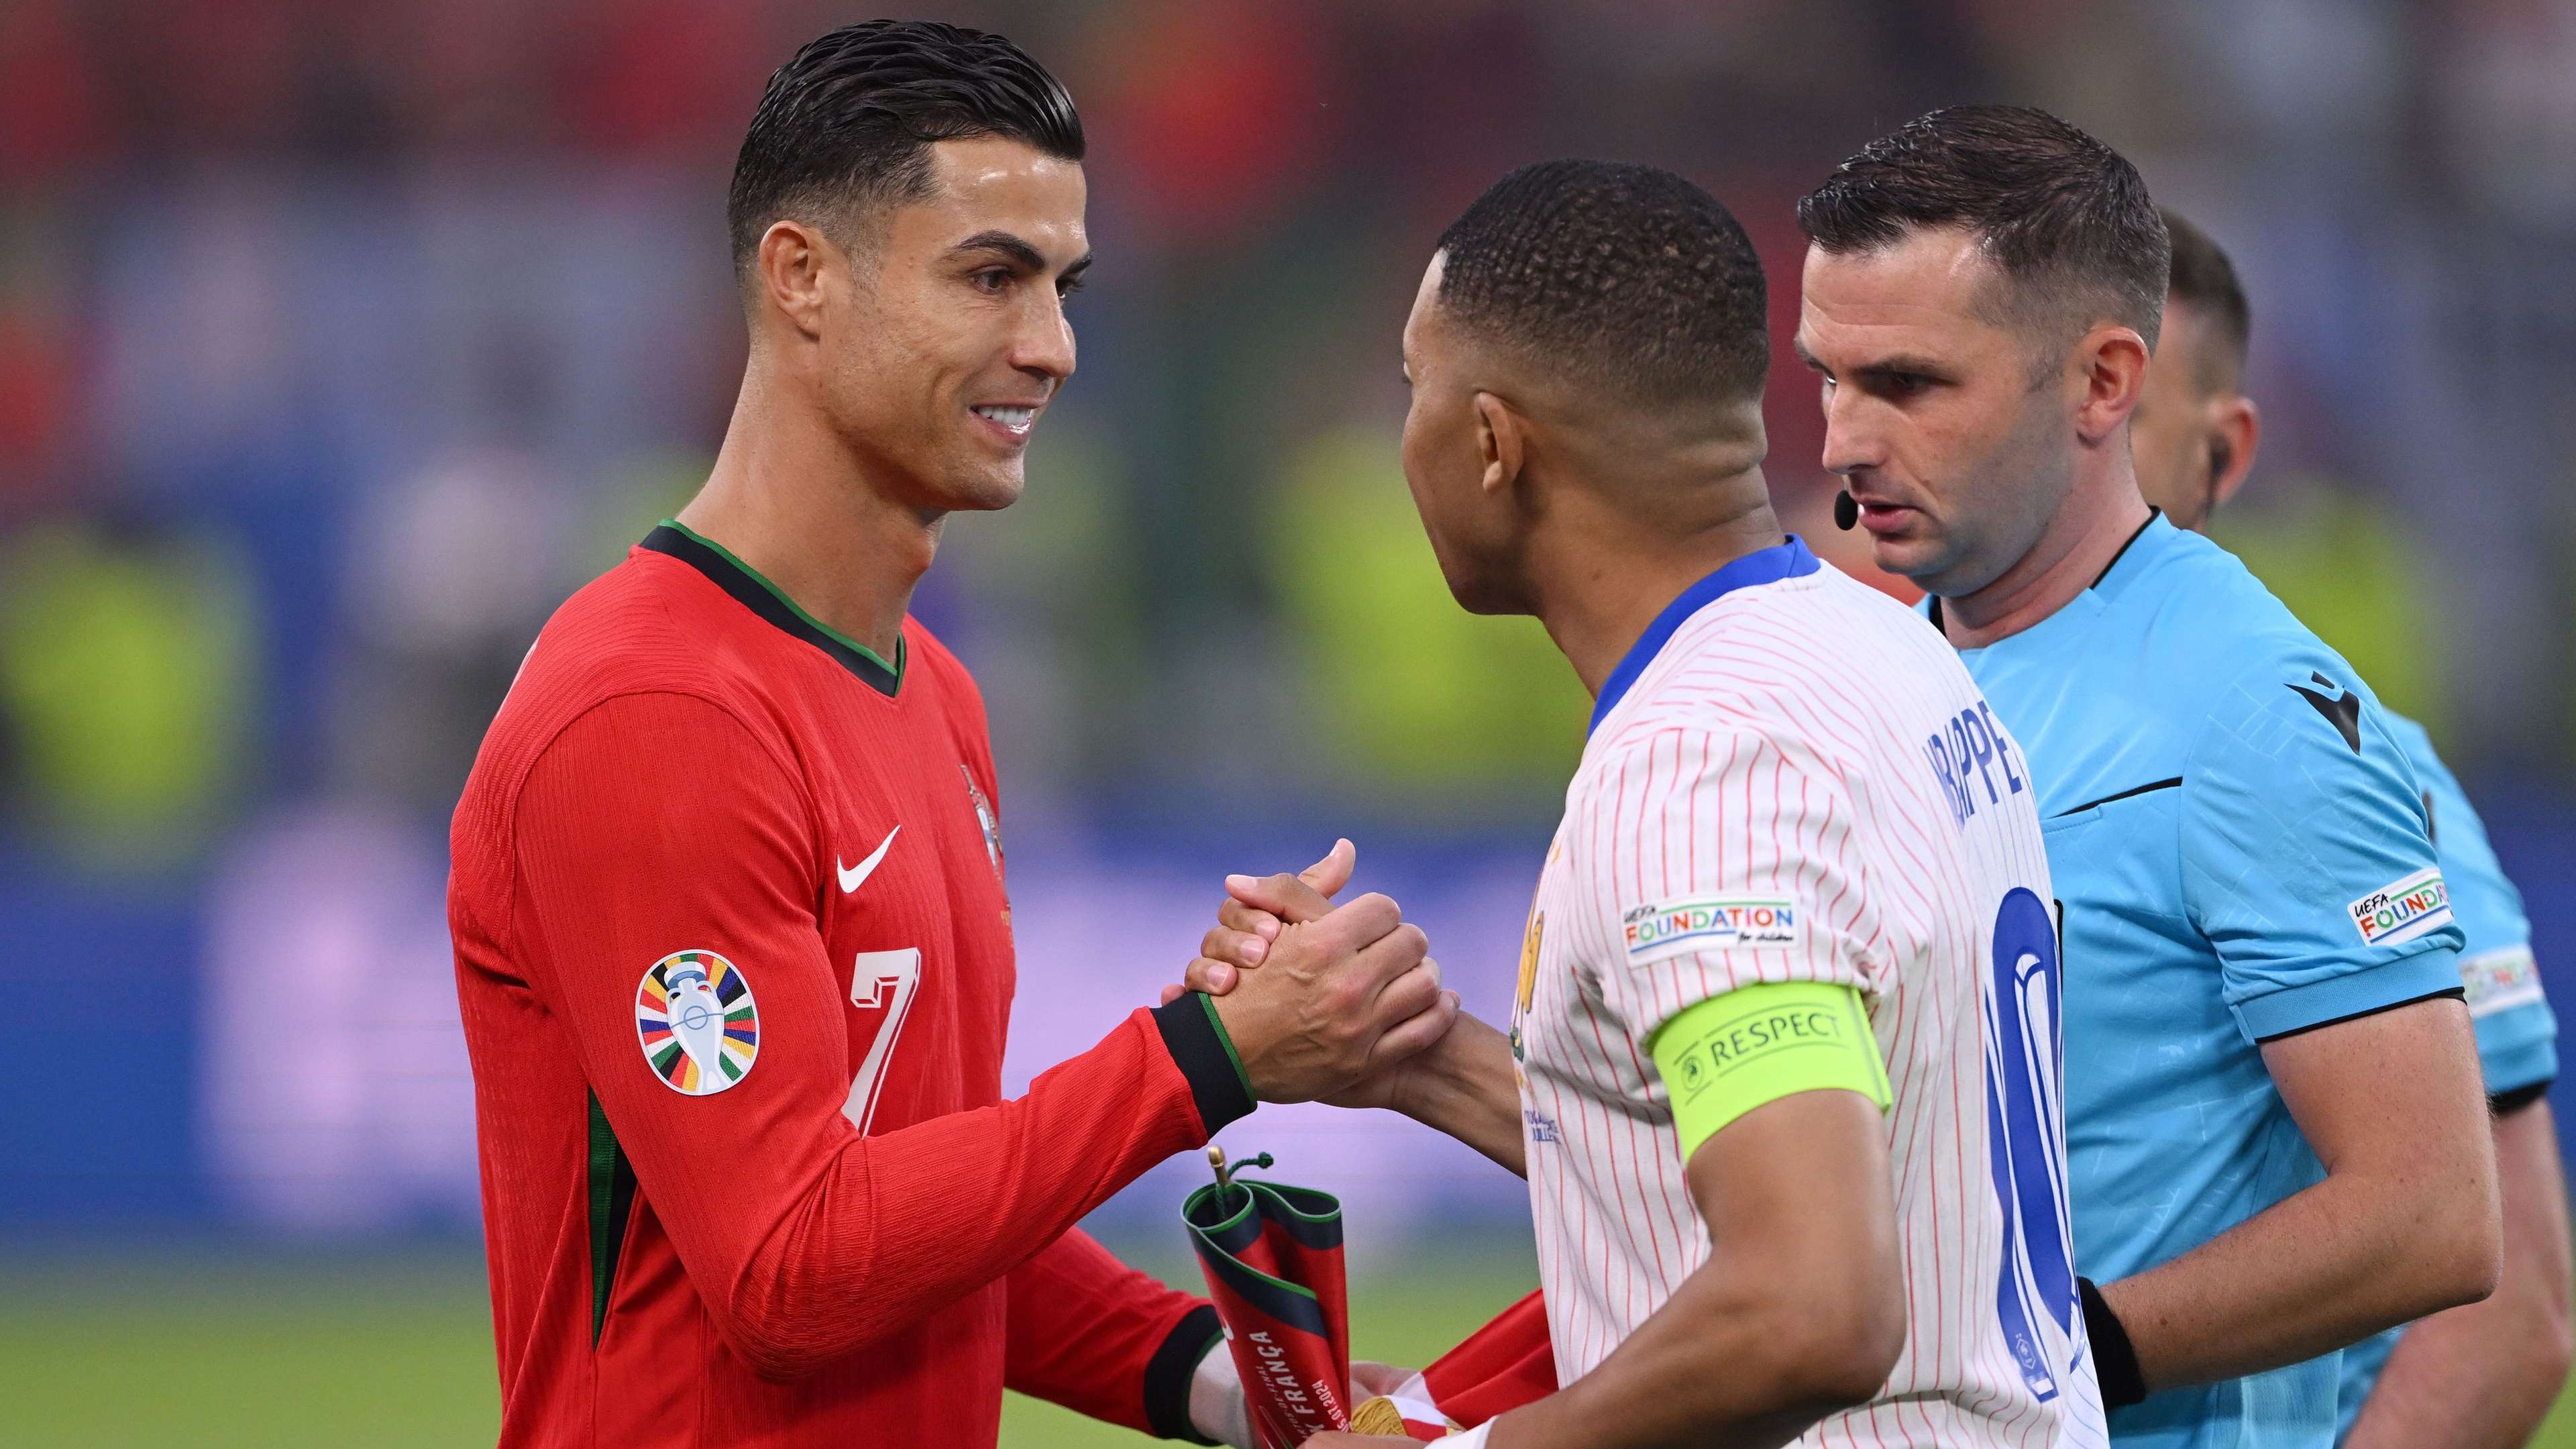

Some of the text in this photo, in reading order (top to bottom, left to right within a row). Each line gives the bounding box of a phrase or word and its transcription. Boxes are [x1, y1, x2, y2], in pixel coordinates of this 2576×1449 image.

[1625, 908, 1793, 946] FOUNDATION
[2355, 894, 2389, 917] UEFA
[2360, 884, 2449, 937] FOUNDA
[841, 947, 921, 1140] 7
[1711, 1012, 1841, 1067] RESPECT
[1249, 1331, 1316, 1414] FRANÇA
